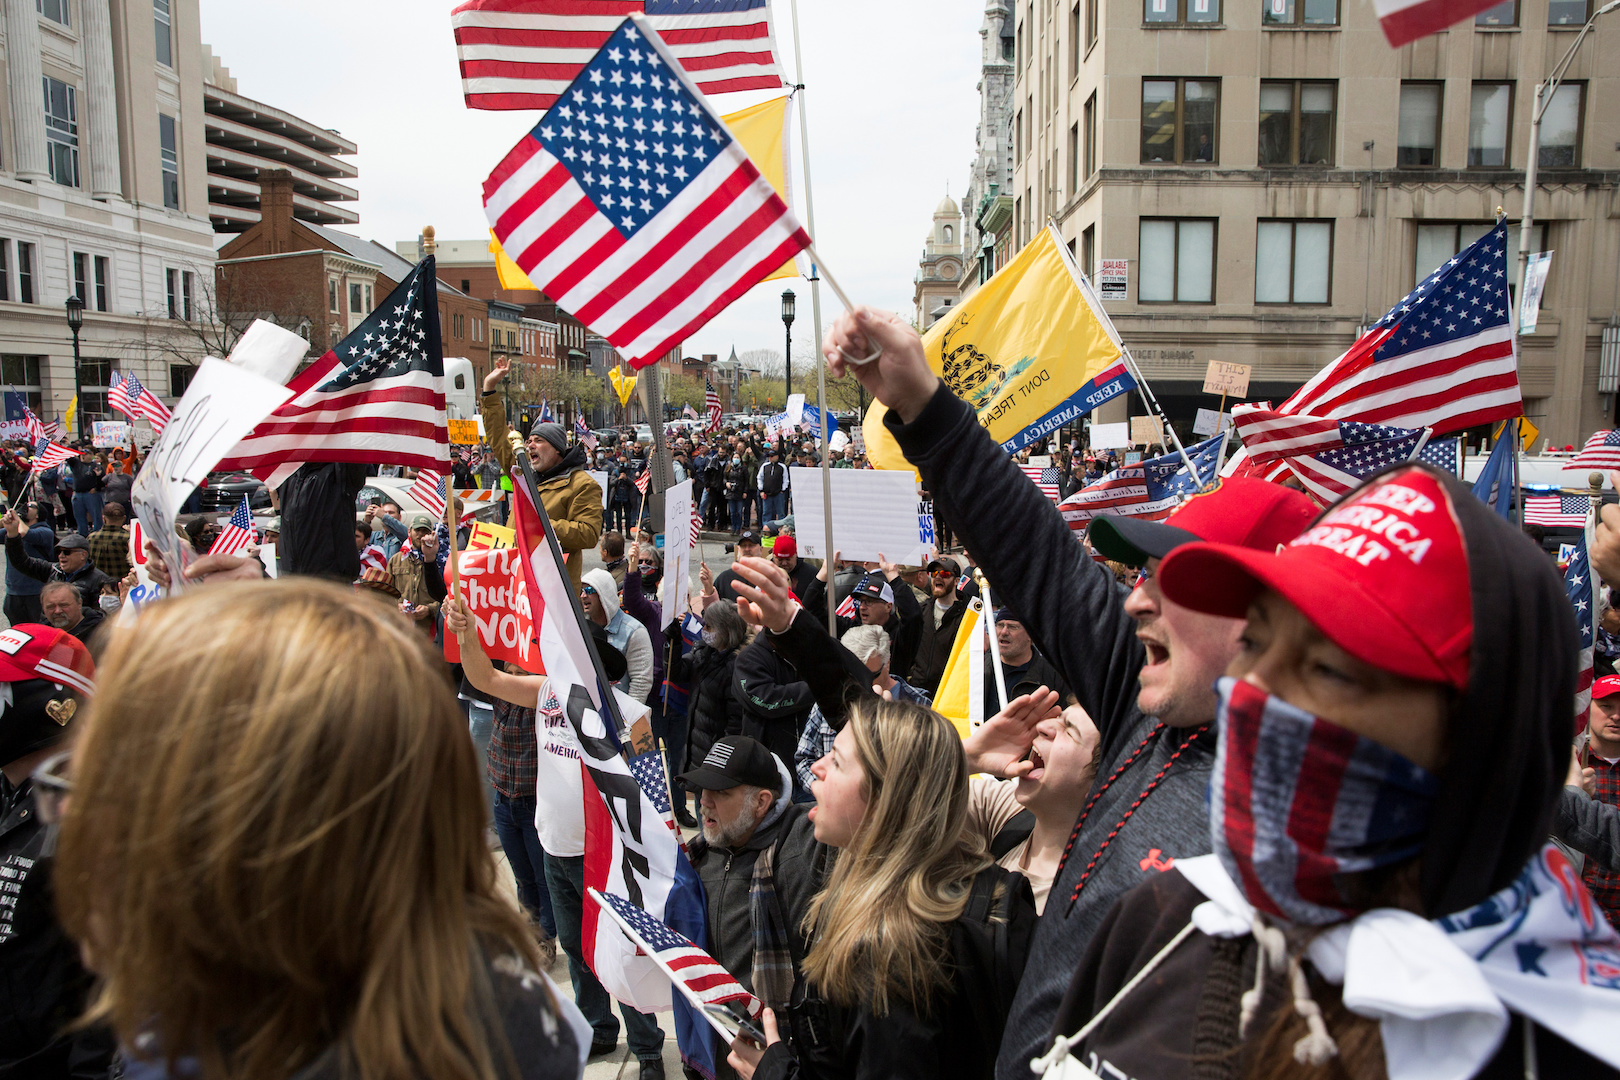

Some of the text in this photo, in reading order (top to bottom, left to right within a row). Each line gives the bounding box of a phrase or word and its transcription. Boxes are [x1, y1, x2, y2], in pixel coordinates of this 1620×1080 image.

[1102, 260, 1127, 270] AVAILABLE
[1216, 362, 1245, 375] THIS
[1217, 374, 1235, 384] IS
[9, 431, 28, 440] NOW
[474, 611, 532, 663] NOW
[544, 740, 580, 760] AMERIC
